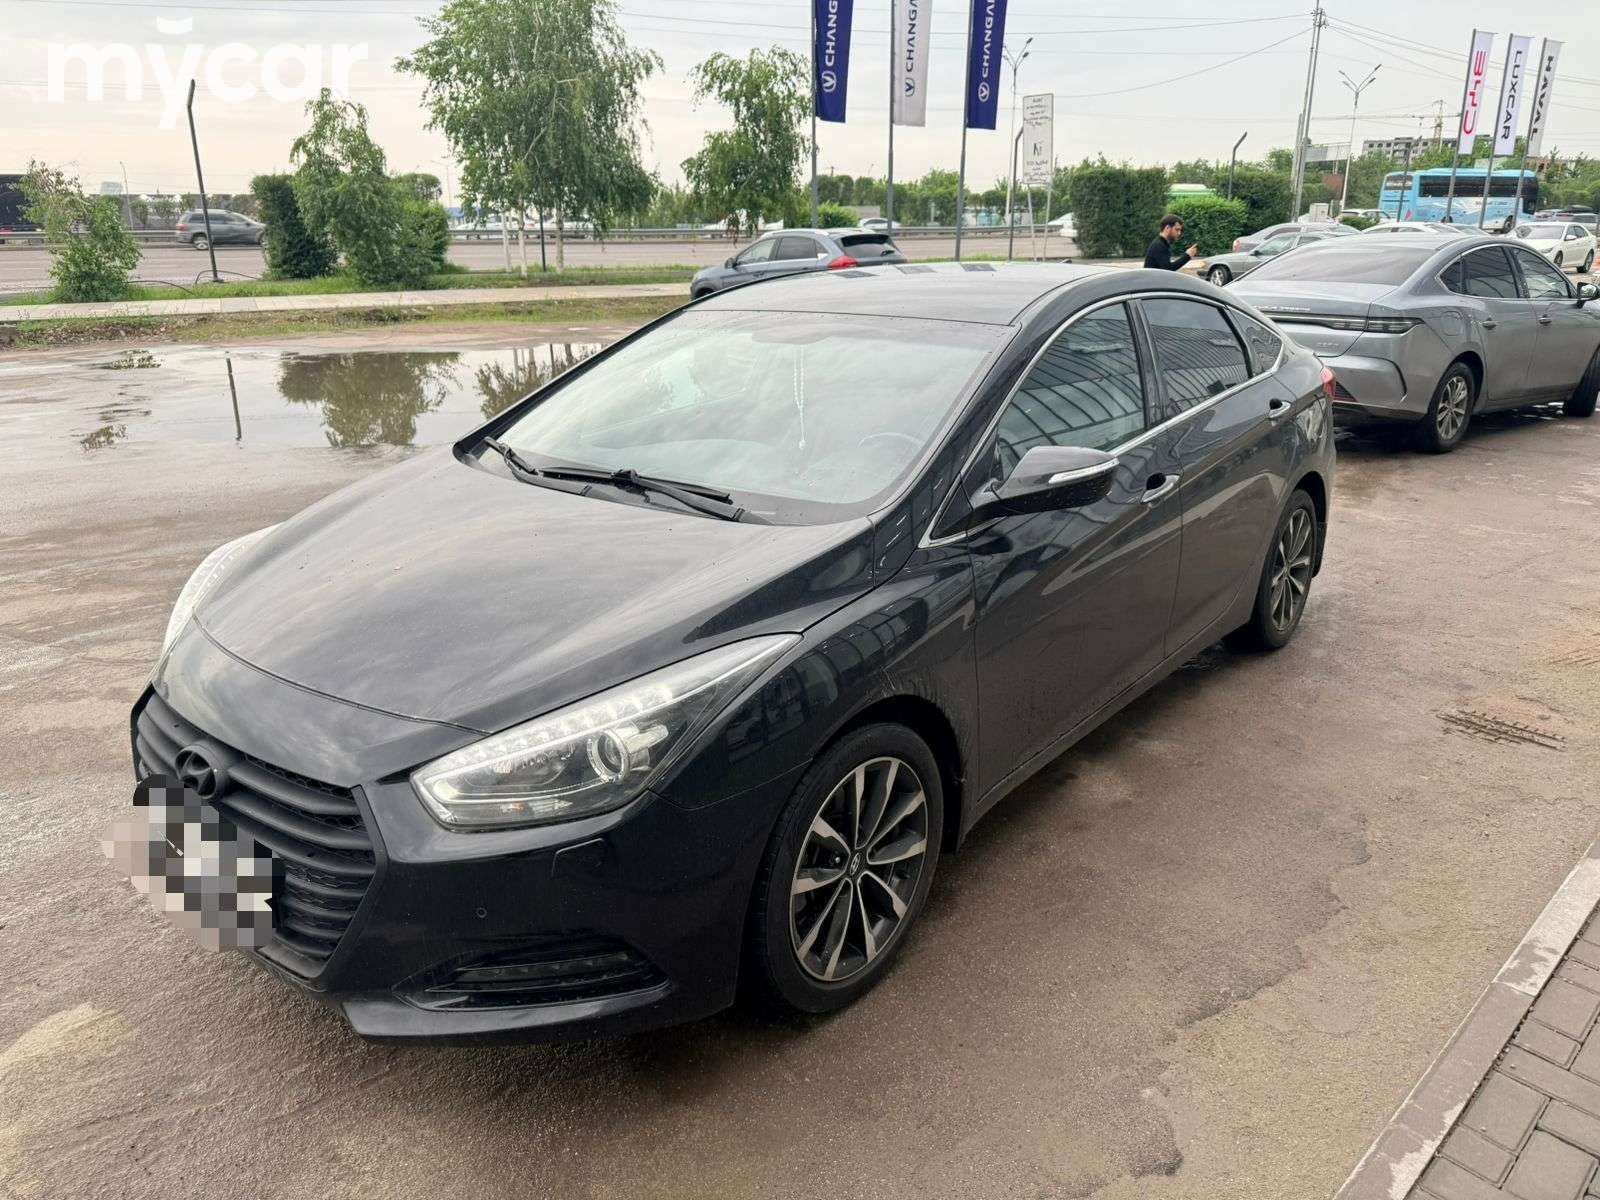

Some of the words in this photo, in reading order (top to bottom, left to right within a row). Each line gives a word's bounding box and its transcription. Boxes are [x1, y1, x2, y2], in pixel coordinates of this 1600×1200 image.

[982, 0, 995, 78] CHANGA
[1501, 50, 1522, 140] LUXCAR
[1531, 56, 1554, 141] HAVAL
